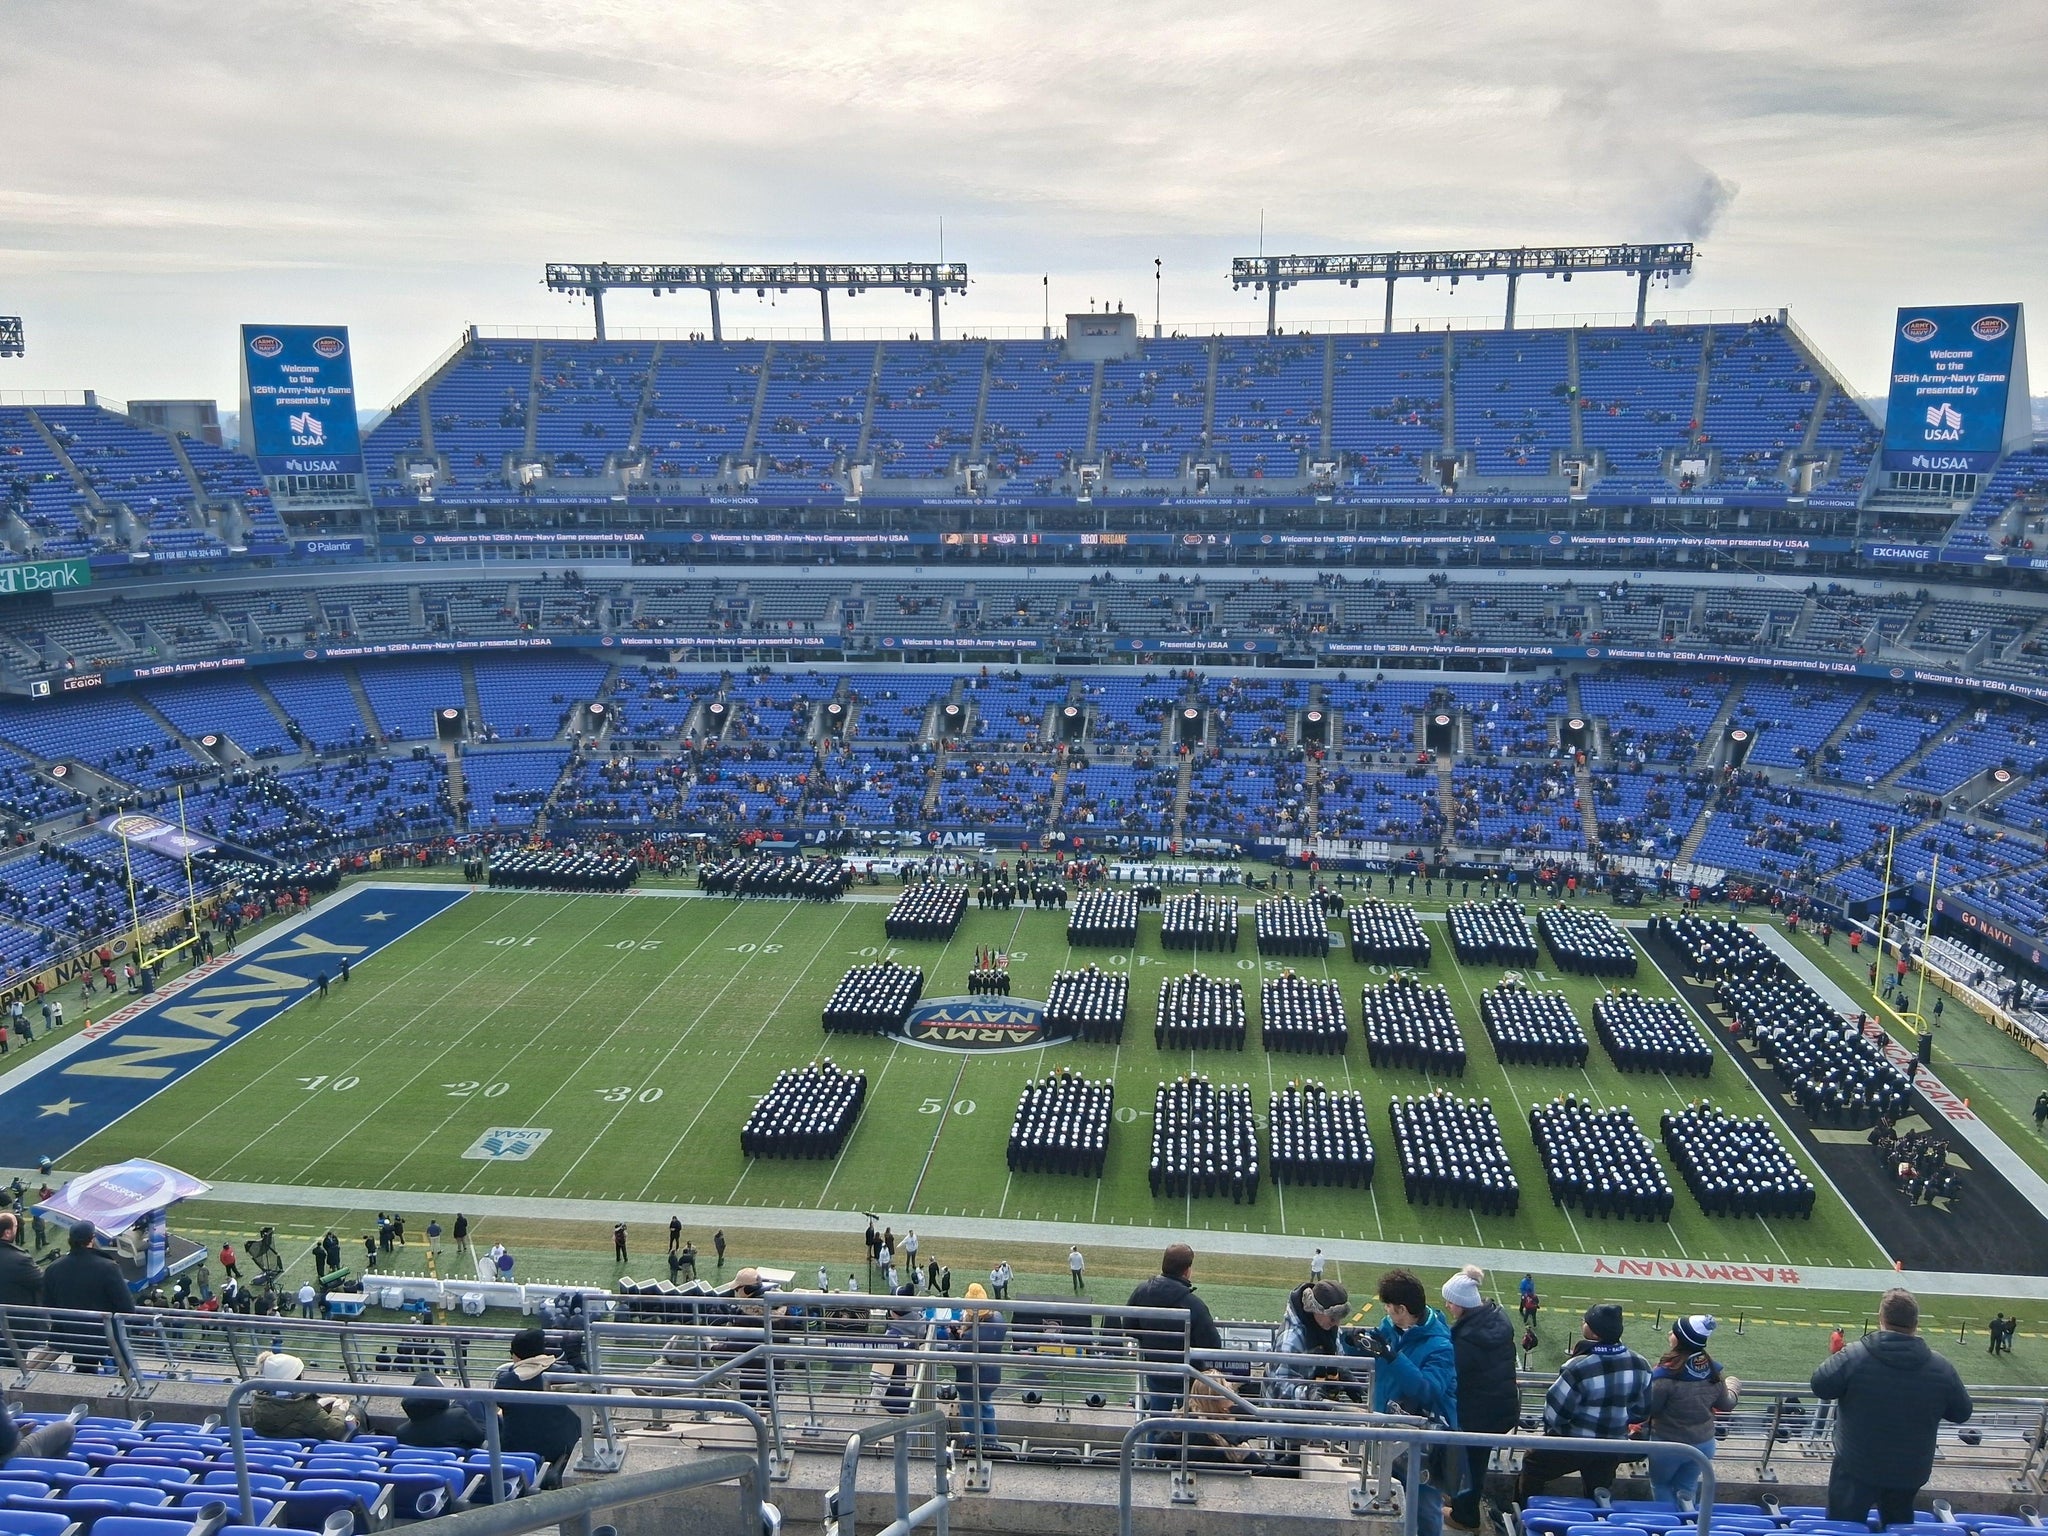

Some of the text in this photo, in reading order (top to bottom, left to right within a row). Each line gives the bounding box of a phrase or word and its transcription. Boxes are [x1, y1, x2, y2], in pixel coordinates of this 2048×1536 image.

[1930, 350, 1973, 359] Welcome
[281, 365, 319, 373] Welcome
[1936, 362, 1964, 370] to the
[1922, 374, 1976, 383] Army-Navy
[1977, 374, 2005, 382] Game
[253, 386, 351, 395] 126th Army-Navy Game
[1916, 386, 1979, 395] presented by
[276, 397, 331, 406] presented by
[1924, 429, 1960, 440] USAA
[292, 436, 324, 446] USAA
[304, 460, 337, 471] USAA
[1931, 457, 1968, 469] USAA
[1666, 497, 1676, 505] YOU
[434, 535, 468, 543] Welcome
[515, 534, 555, 542] Army-Navy
[557, 533, 576, 541] Game
[578, 533, 613, 542] presented
[614, 533, 623, 542] by
[624, 533, 644, 541] USAA
[1099, 534, 1127, 544] PREGAME
[1281, 534, 1312, 543] Welcome
[1315, 535, 1321, 543] to
[1323, 535, 1334, 543] the
[1358, 535, 1399, 544] Army-Navy
[1401, 535, 1421, 543] Game
[1424, 536, 1460, 544] presented
[1463, 534, 1472, 544] by
[1474, 535, 1495, 543] USAA
[1571, 535, 1606, 544] Welcome
[1608, 536, 1616, 544] to
[1618, 536, 1630, 544] the
[1656, 537, 1702, 546] Army-Navy
[1704, 537, 1727, 546] Game
[1730, 539, 1771, 547] presented
[1773, 539, 1783, 549] by
[1786, 540, 1809, 548] USAA
[317, 542, 352, 551] Palantir
[154, 552, 166, 560] TEXT
[166, 551, 176, 559] FOR
[176, 550, 188, 559] HELP
[1873, 547, 1929, 559] EXCHANGE
[22, 563, 79, 590] Bank
[326, 647, 362, 656] Welcome
[374, 645, 386, 653] the
[412, 642, 455, 650] Army-Navy
[480, 639, 517, 648] presented
[520, 638, 528, 647] by
[530, 638, 551, 646] USAA
[621, 637, 653, 645] Welcome
[697, 637, 735, 646] Army-Navy
[737, 637, 756, 645] Game
[758, 637, 793, 646] presented
[795, 637, 802, 646] by
[805, 637, 824, 645] USAA
[903, 638, 933, 646] Welcome
[943, 638, 954, 646] the
[976, 639, 1015, 647] Army-Navy
[1017, 639, 1036, 647] Game
[1160, 641, 1227, 650] Presented by USAA
[1609, 649, 1644, 658] Welcome
[1647, 650, 1655, 658] to
[1658, 651, 1670, 659] the
[1697, 653, 1745, 663] Army-Navy
[1748, 656, 1771, 665] Game
[1774, 659, 1817, 669] presented
[1820, 661, 1829, 671] by
[1832, 662, 1856, 672] USAA
[135, 668, 149, 677] The
[176, 661, 220, 671] Army-Navy
[222, 658, 245, 666] Game
[64, 678, 102, 690] LEGION
[1915, 671, 1952, 683] Welcome
[1955, 674, 1964, 684] to
[1966, 676, 1980, 687] the
[2009, 683, 2048, 697] Army-Na
[928, 831, 986, 846] GAME
[1961, 912, 2013, 947] GO NAVY!
[496, 936, 541, 947] 10
[615, 940, 664, 950] 20
[735, 943, 784, 954] 30
[1109, 955, 1153, 966] 40
[1236, 959, 1282, 971] 30
[1369, 964, 1416, 976] 20
[81, 952, 242, 1039] AMERICA'S GAME
[60, 932, 370, 1080] NAVY
[928, 1008, 1035, 1024] NAVY
[916, 1027, 1036, 1043] ARMY
[2005, 1022, 2036, 1050] ARMY
[300, 1075, 360, 1091] 10
[445, 1081, 510, 1098] 20
[603, 1086, 664, 1103] 30
[1915, 1080, 1976, 1120] GAME
[918, 1098, 976, 1116] 50
[494, 1130, 541, 1139] USAA
[1594, 1258, 1801, 1284] #ARMYNAVY
